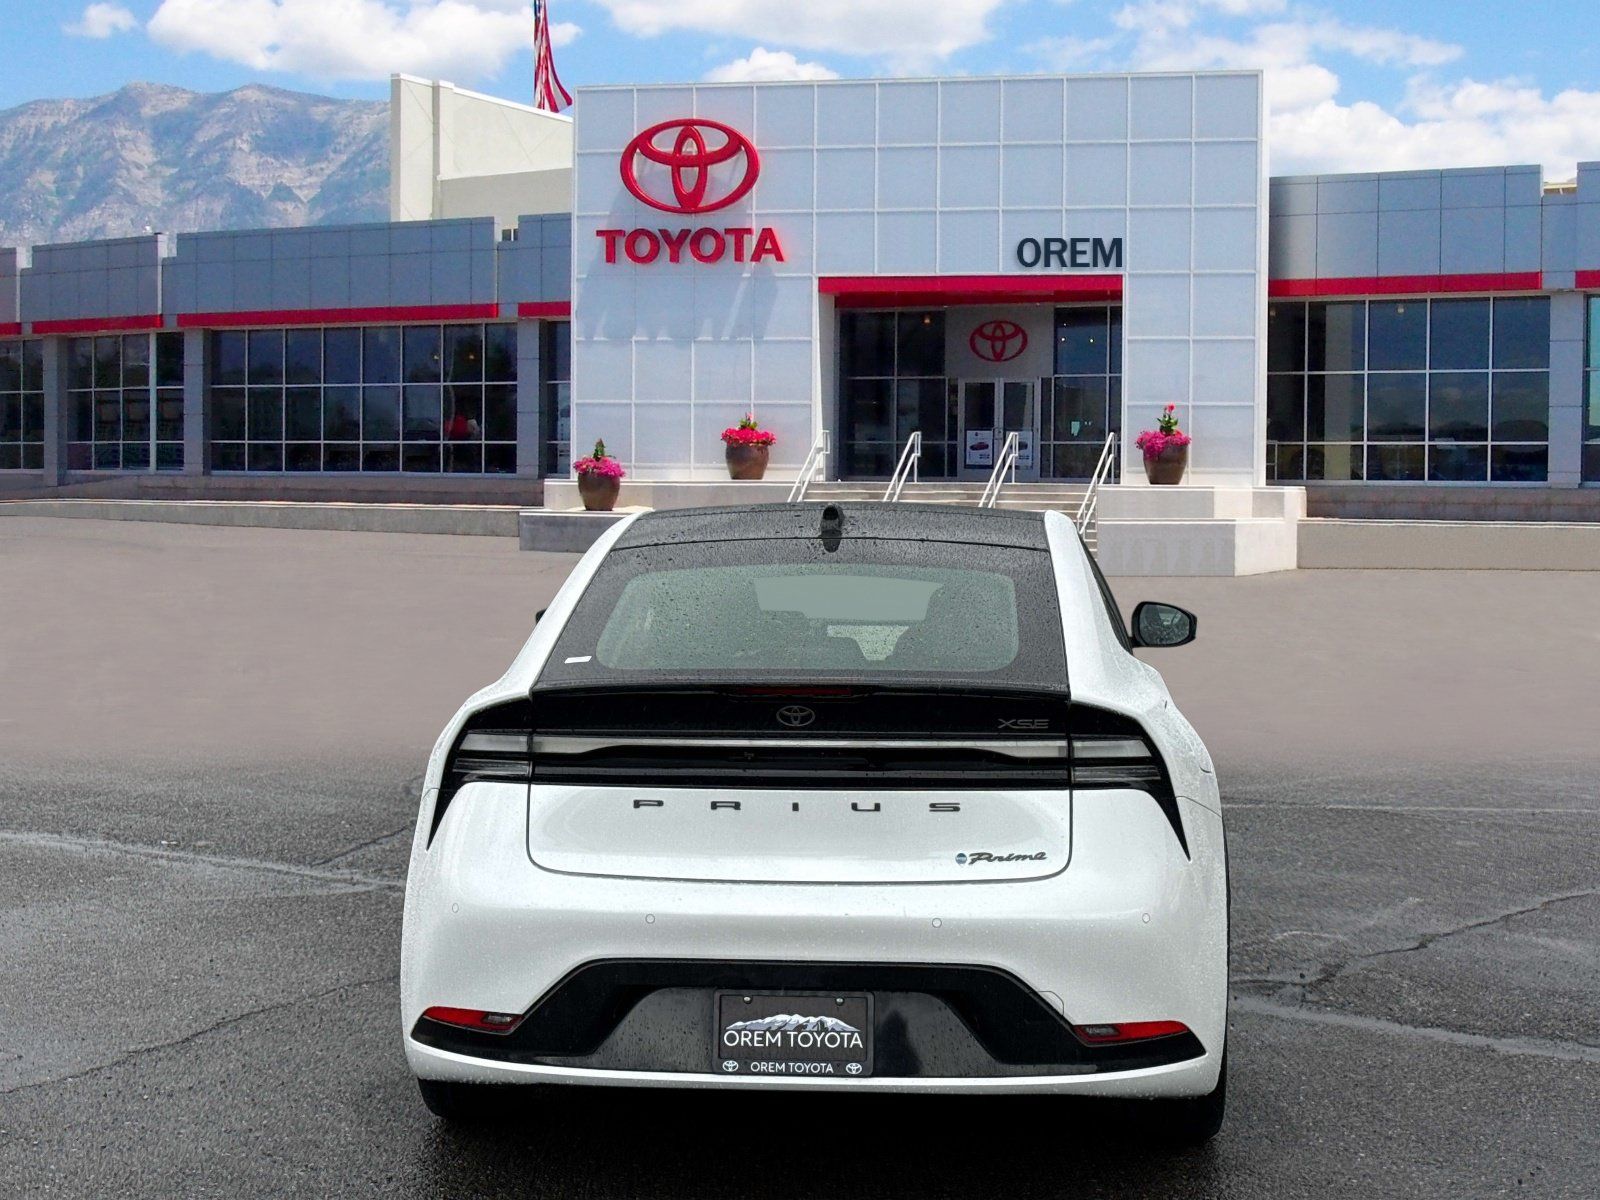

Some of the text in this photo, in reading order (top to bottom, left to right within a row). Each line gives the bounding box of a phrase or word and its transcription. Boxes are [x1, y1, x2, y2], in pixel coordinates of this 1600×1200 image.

[596, 227, 785, 264] TOYOTA
[1017, 237, 1123, 268] OREM
[998, 718, 1050, 729] XSE
[633, 799, 961, 812] PRIUS
[968, 851, 1048, 865] Prime
[723, 1030, 863, 1048] OREM TOYOTA
[750, 1061, 834, 1074] OREM TOYOTA
